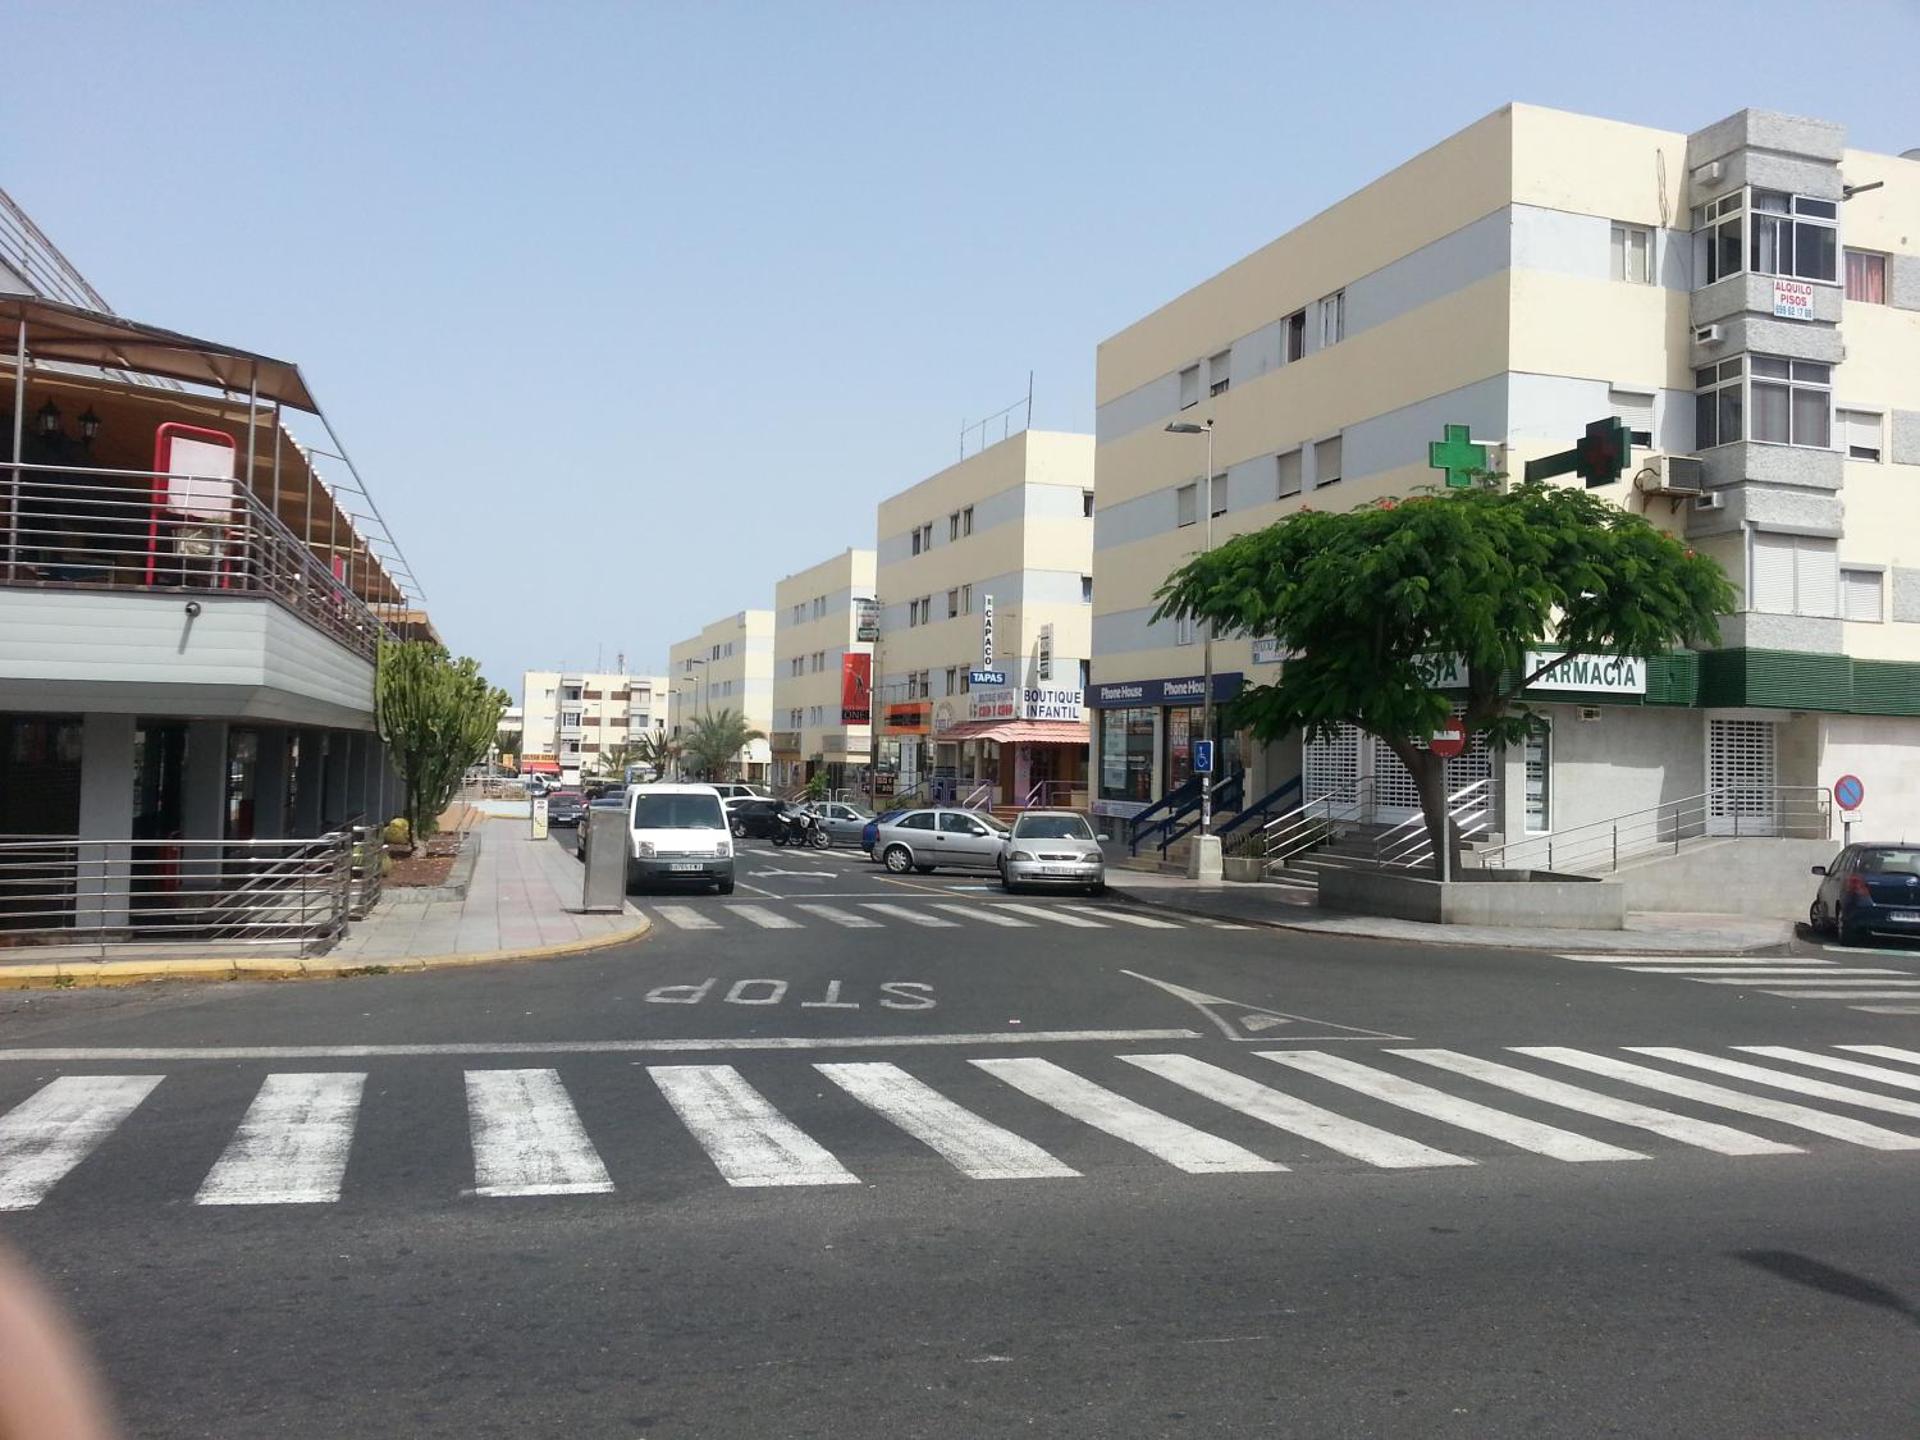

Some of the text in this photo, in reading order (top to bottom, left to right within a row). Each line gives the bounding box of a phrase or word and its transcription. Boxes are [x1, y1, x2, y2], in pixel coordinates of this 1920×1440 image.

[1775, 281, 1812, 295] ALQUILO
[1780, 293, 1807, 307] PISOS
[984, 609, 992, 666] CAPACO
[972, 673, 1004, 684] TAPAS
[1101, 685, 1143, 700] Phone House
[1163, 682, 1187, 696] Phone
[1024, 689, 1081, 704] BOUTIQUE
[1026, 705, 1079, 719] INFANTIL
[644, 977, 937, 1010] STOP
